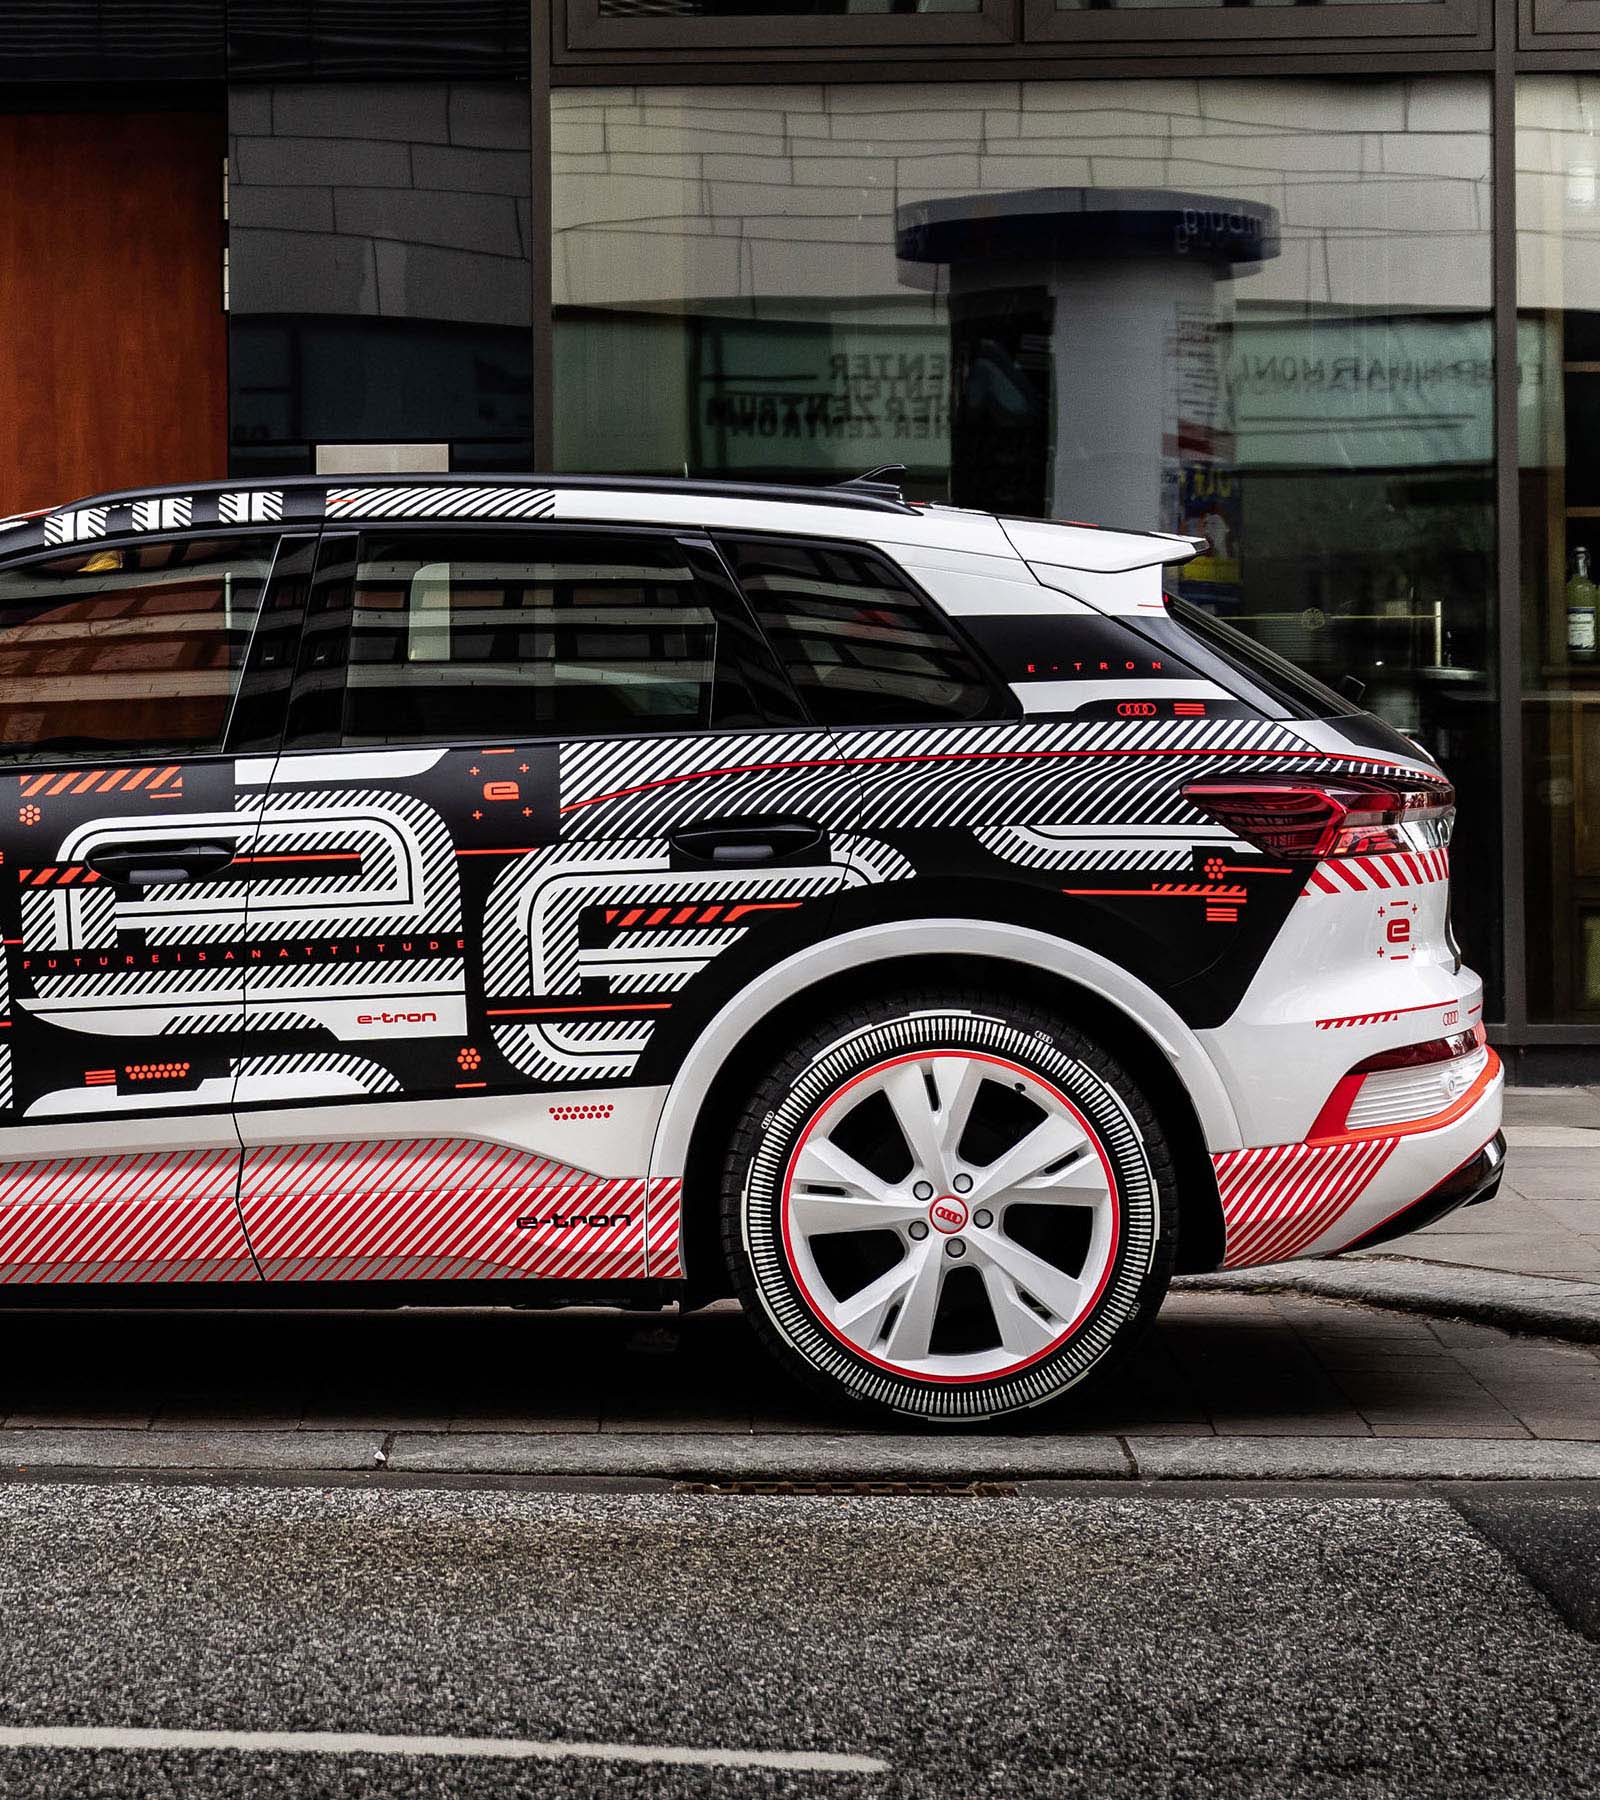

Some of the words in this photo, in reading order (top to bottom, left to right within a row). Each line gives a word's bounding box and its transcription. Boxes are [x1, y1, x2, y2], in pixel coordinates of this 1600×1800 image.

[1026, 660, 1163, 673] E-TRON
[356, 1011, 437, 1026] e-tron
[516, 1213, 632, 1229] e-tron
